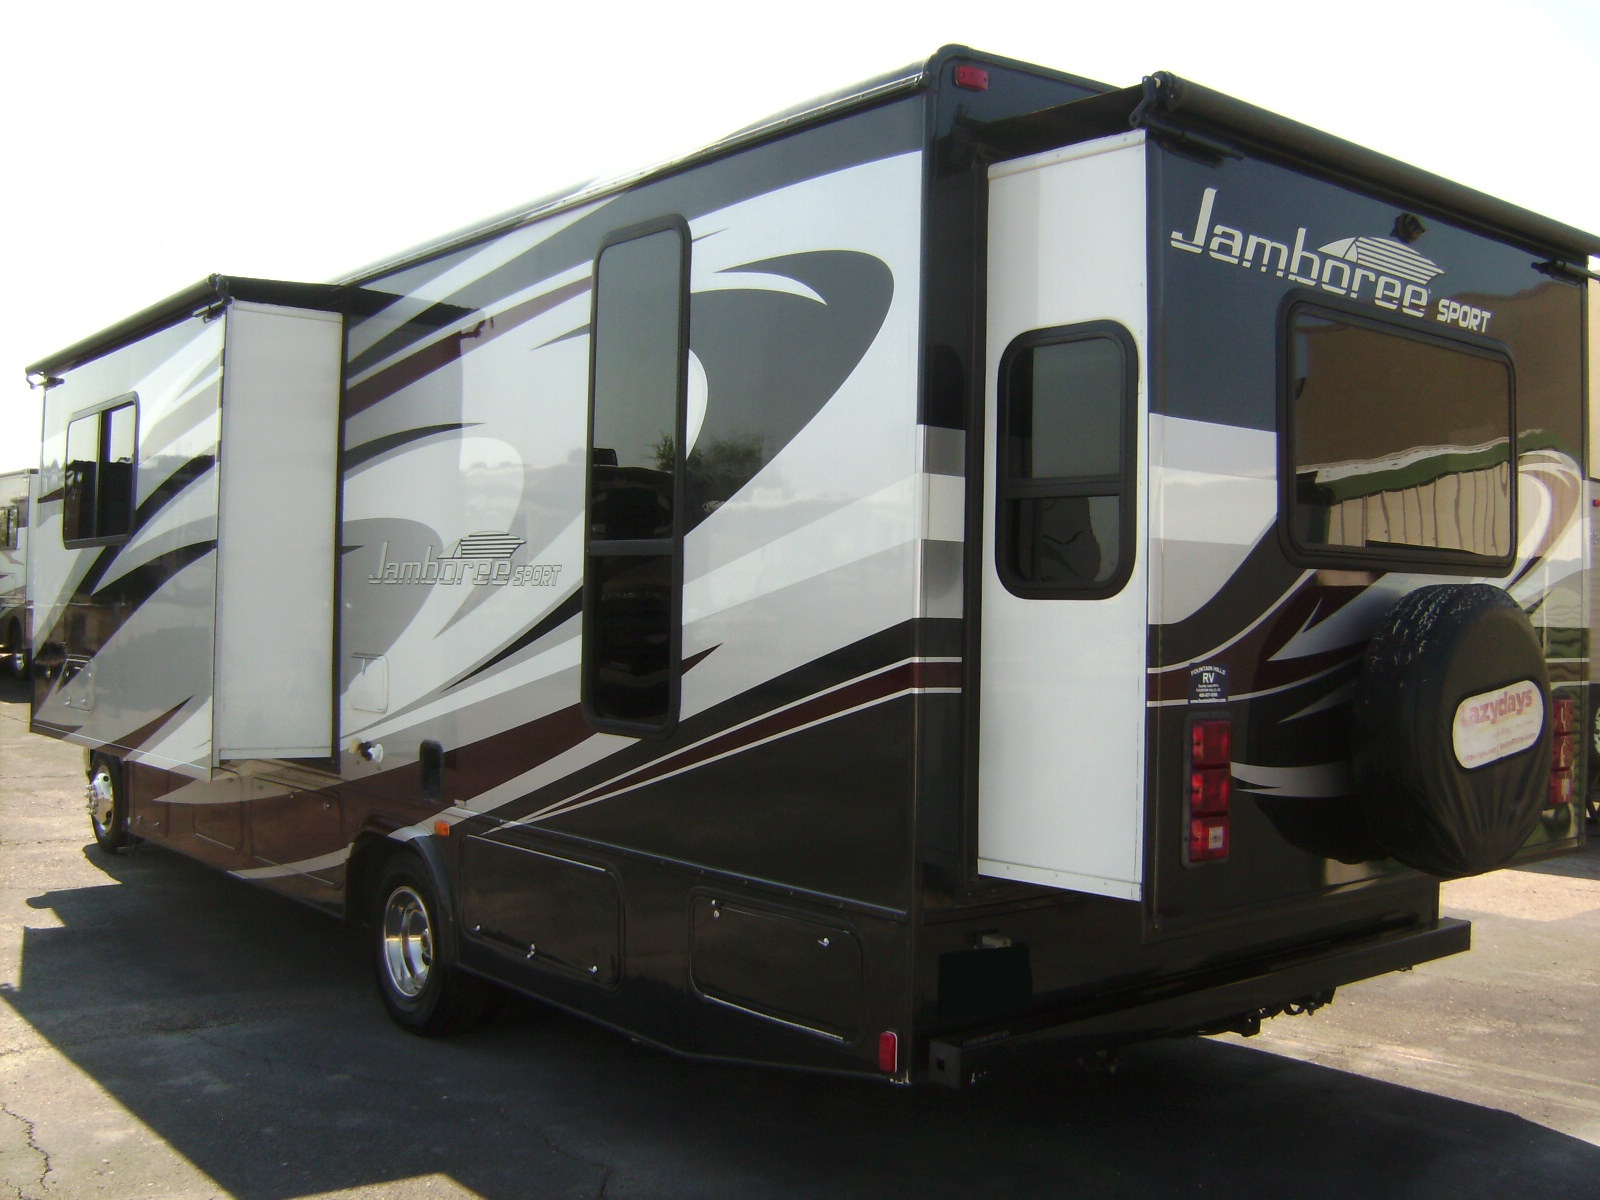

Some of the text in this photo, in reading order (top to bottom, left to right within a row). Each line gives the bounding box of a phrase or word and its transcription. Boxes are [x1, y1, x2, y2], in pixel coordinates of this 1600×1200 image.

[1170, 187, 1491, 333] Jamboree SPORT
[369, 541, 563, 587] Jamboree SPORT
[1203, 672, 1215, 684] RV
